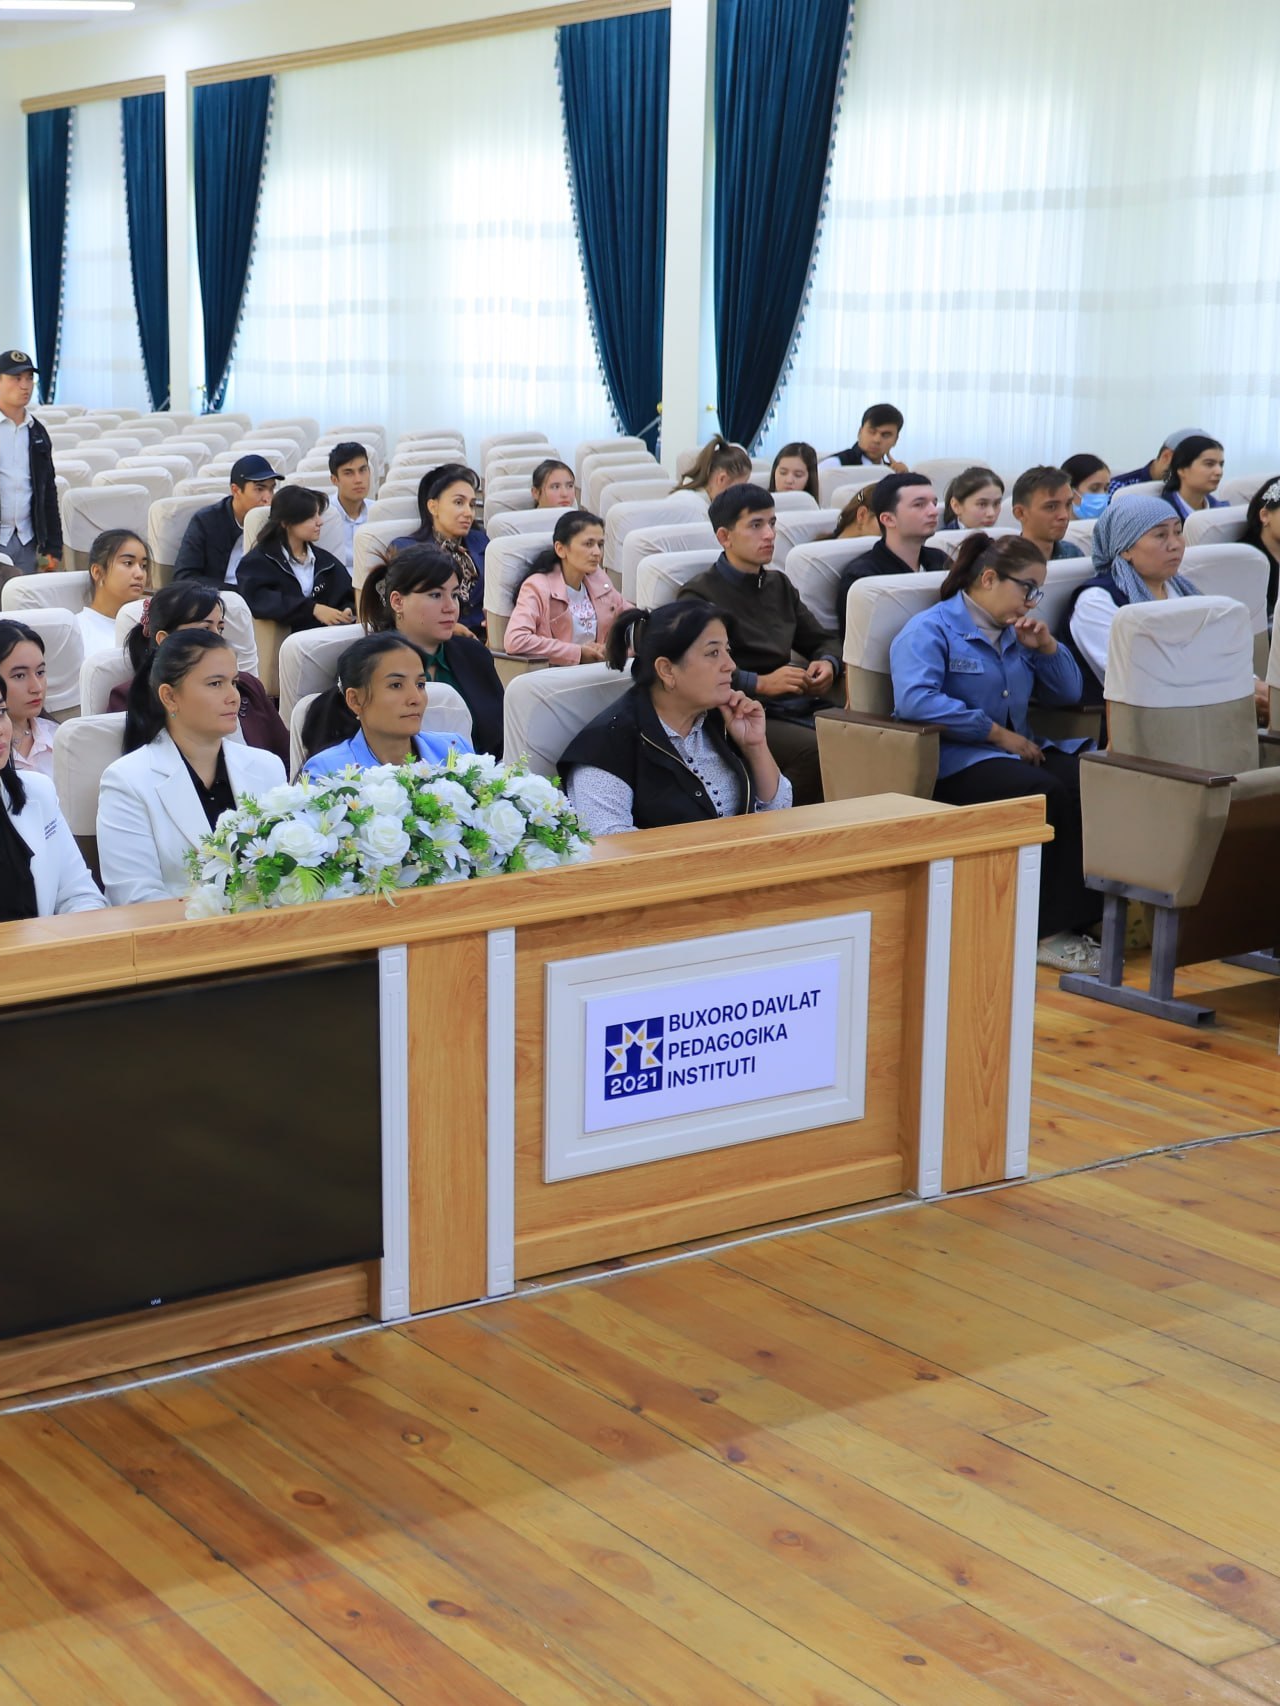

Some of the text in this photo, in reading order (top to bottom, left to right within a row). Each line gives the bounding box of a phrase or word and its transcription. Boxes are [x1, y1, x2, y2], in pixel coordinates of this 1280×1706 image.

[669, 989, 821, 1033] BUXORO DAVLAT
[668, 1023, 789, 1060] PEDAGOGIKA
[610, 1071, 658, 1096] 2021
[668, 1055, 756, 1089] INSTITUTI
